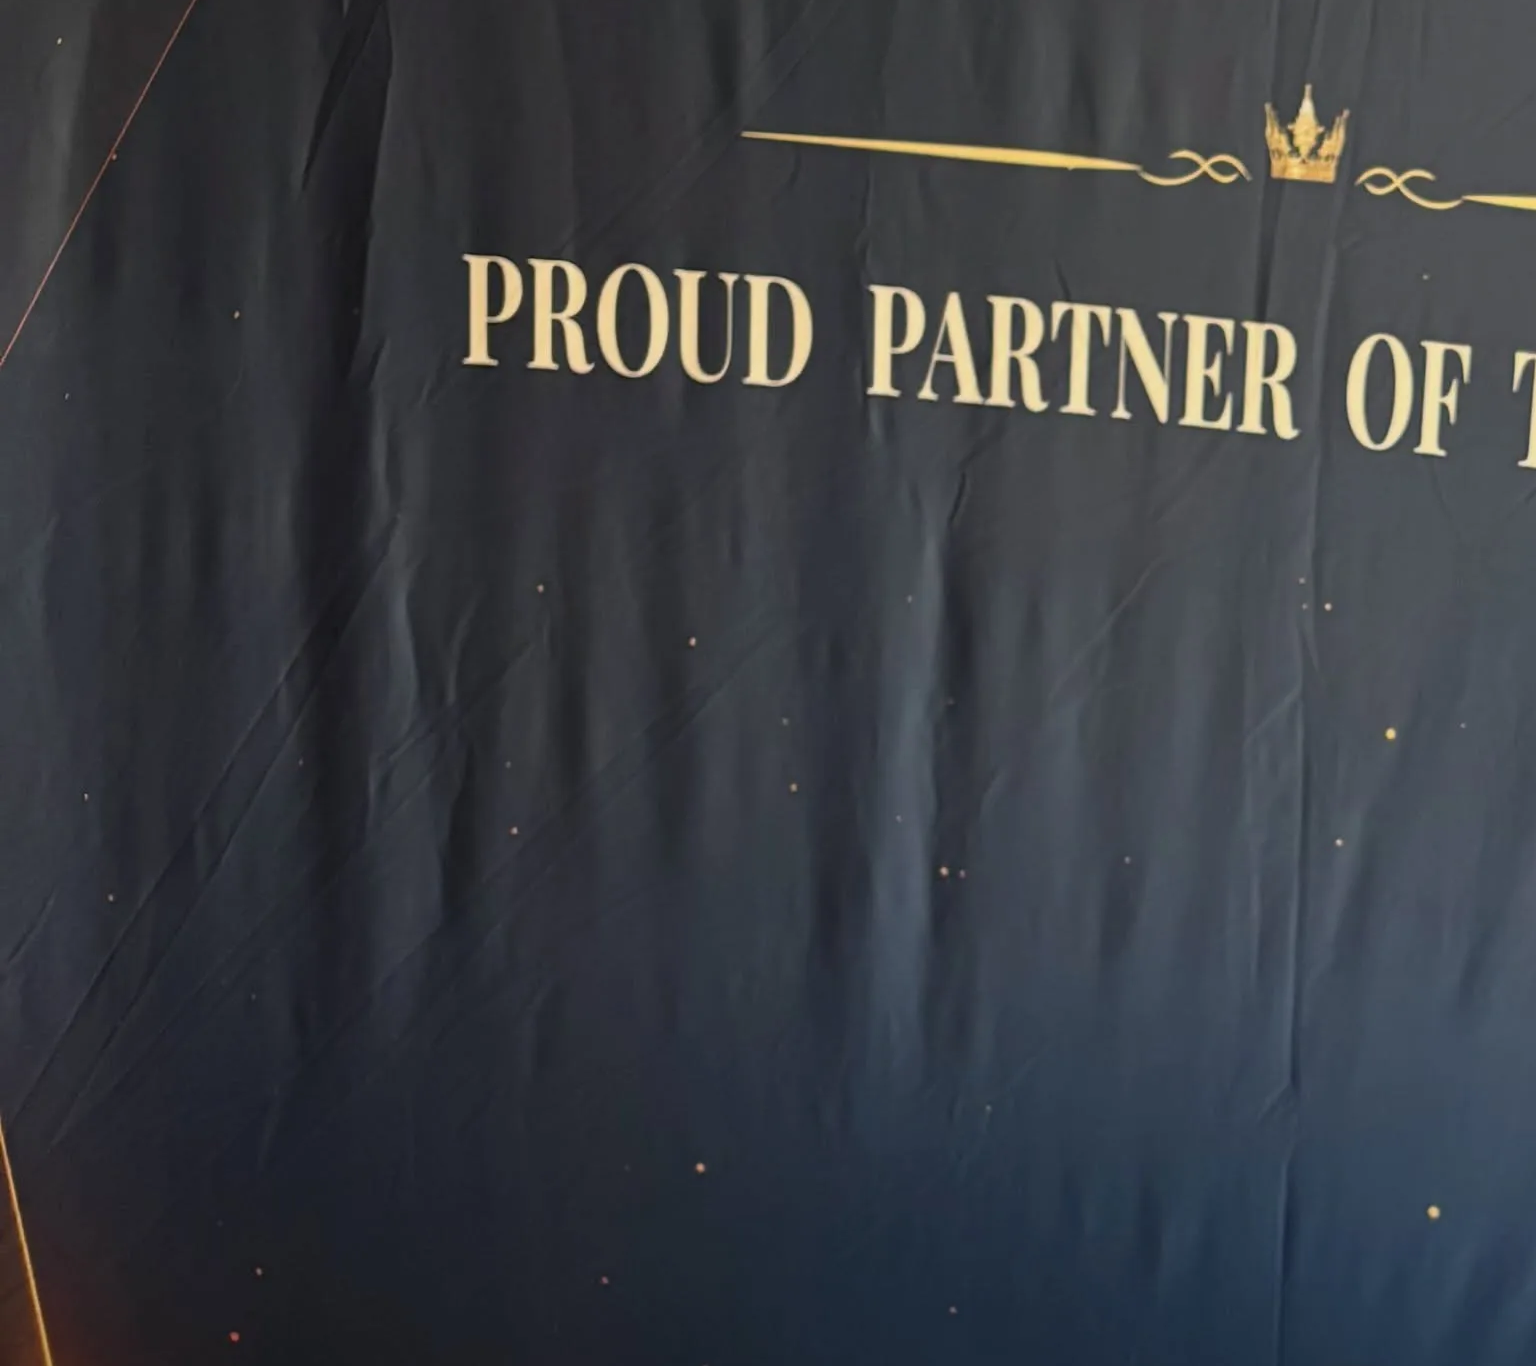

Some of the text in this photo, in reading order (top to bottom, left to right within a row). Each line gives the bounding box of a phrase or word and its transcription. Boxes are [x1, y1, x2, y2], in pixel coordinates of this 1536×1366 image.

[463, 253, 813, 387] PROUD
[867, 283, 1299, 440] PARTNER
[1346, 332, 1472, 457] OF
